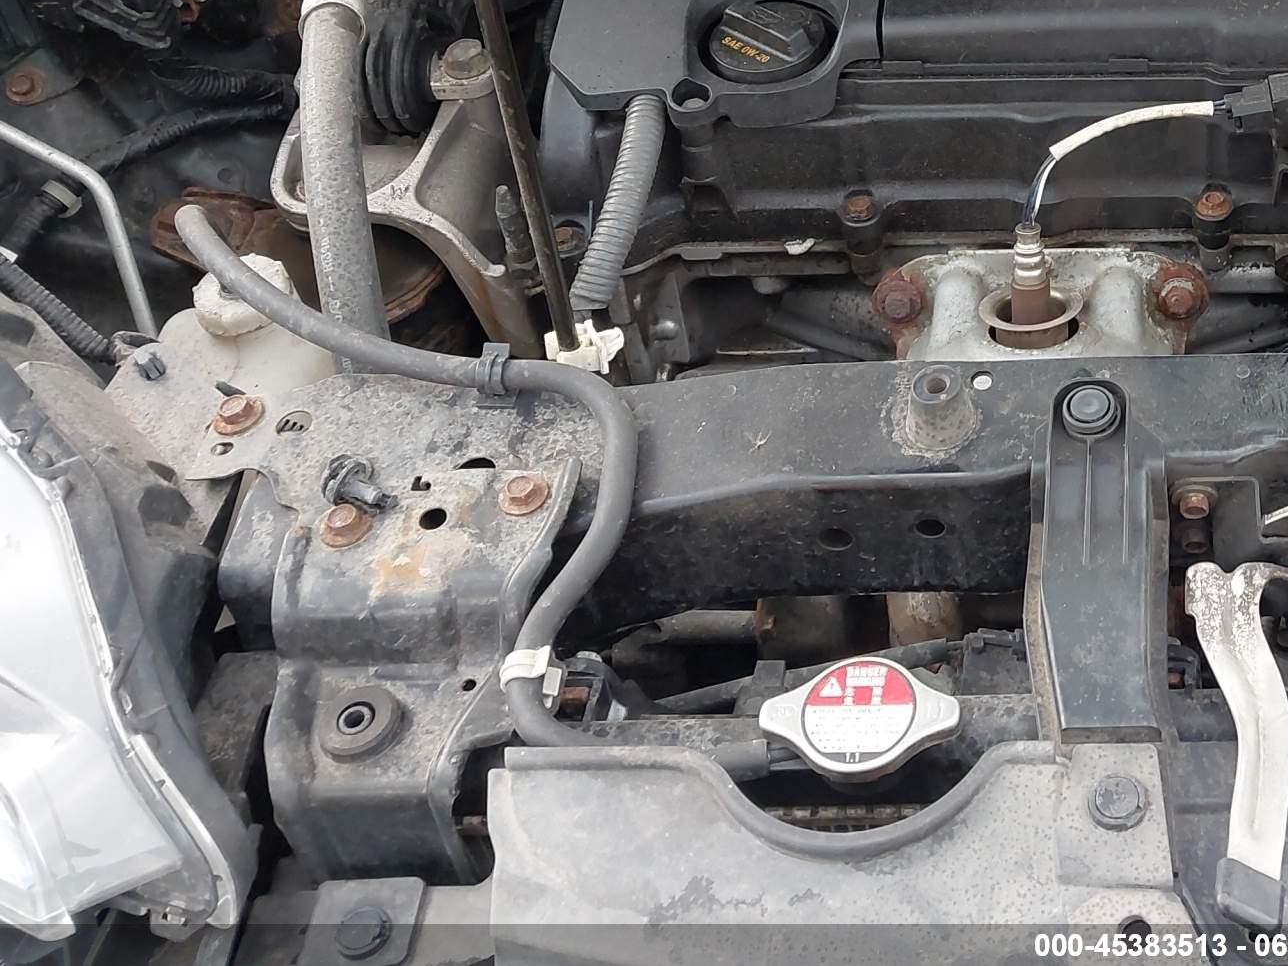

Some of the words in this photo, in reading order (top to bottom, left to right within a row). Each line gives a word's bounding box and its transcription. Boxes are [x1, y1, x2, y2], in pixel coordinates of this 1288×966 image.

[721, 35, 743, 51] SAE
[741, 45, 771, 64] 0W-20
[846, 752, 860, 763] 1.1
